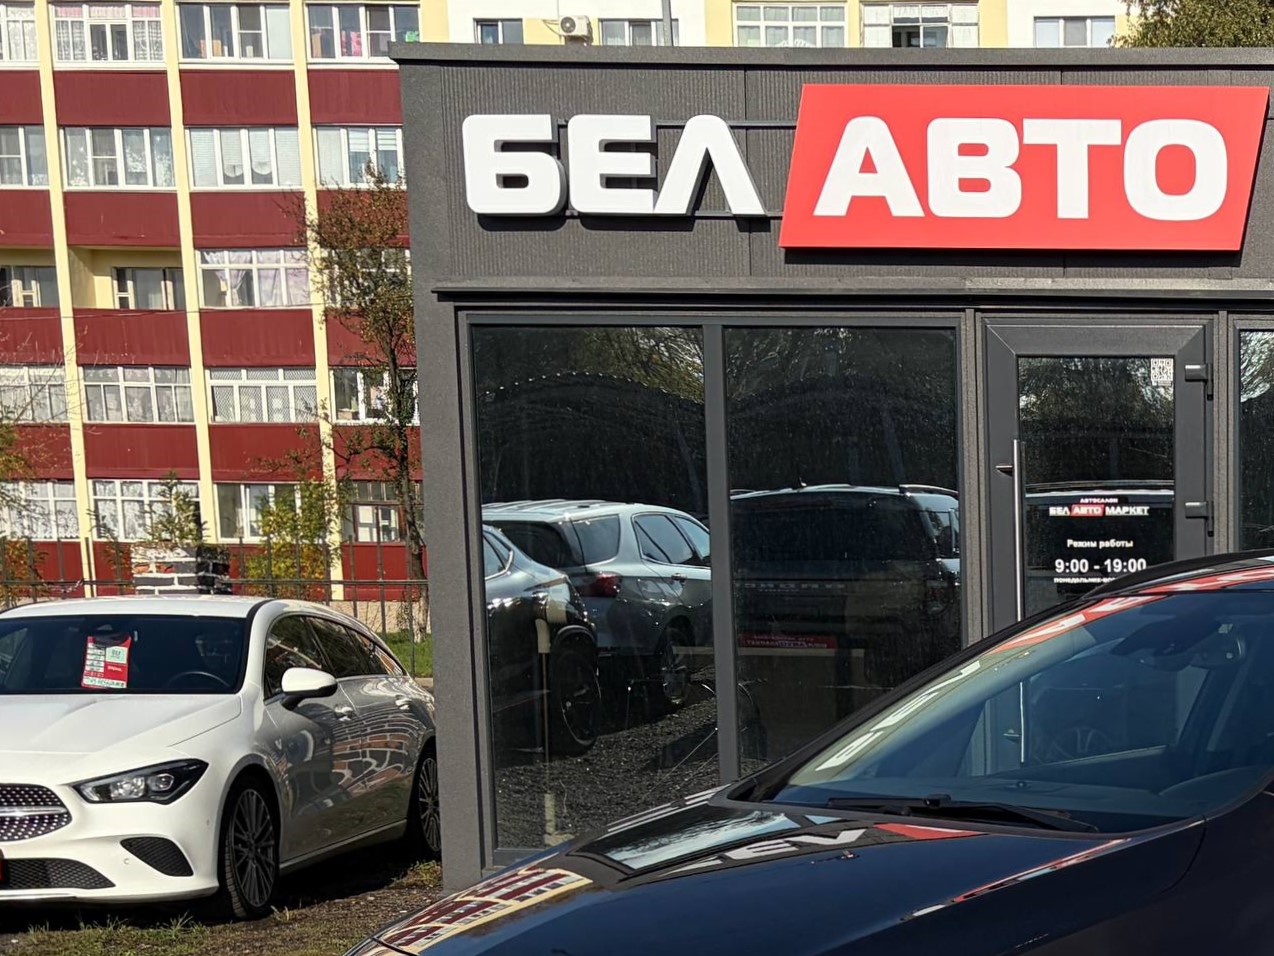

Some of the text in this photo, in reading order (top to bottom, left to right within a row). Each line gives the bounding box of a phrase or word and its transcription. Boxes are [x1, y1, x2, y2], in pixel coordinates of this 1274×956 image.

[462, 114, 768, 217] БЕЛ
[813, 116, 1229, 221] АВТО
[1073, 506, 1102, 515] АВТО
[1105, 506, 1150, 516] МАРКЕТ
[1067, 539, 1133, 549] Режим работы
[1055, 558, 1089, 573] 9:00
[1104, 558, 1147, 572] 19:00
